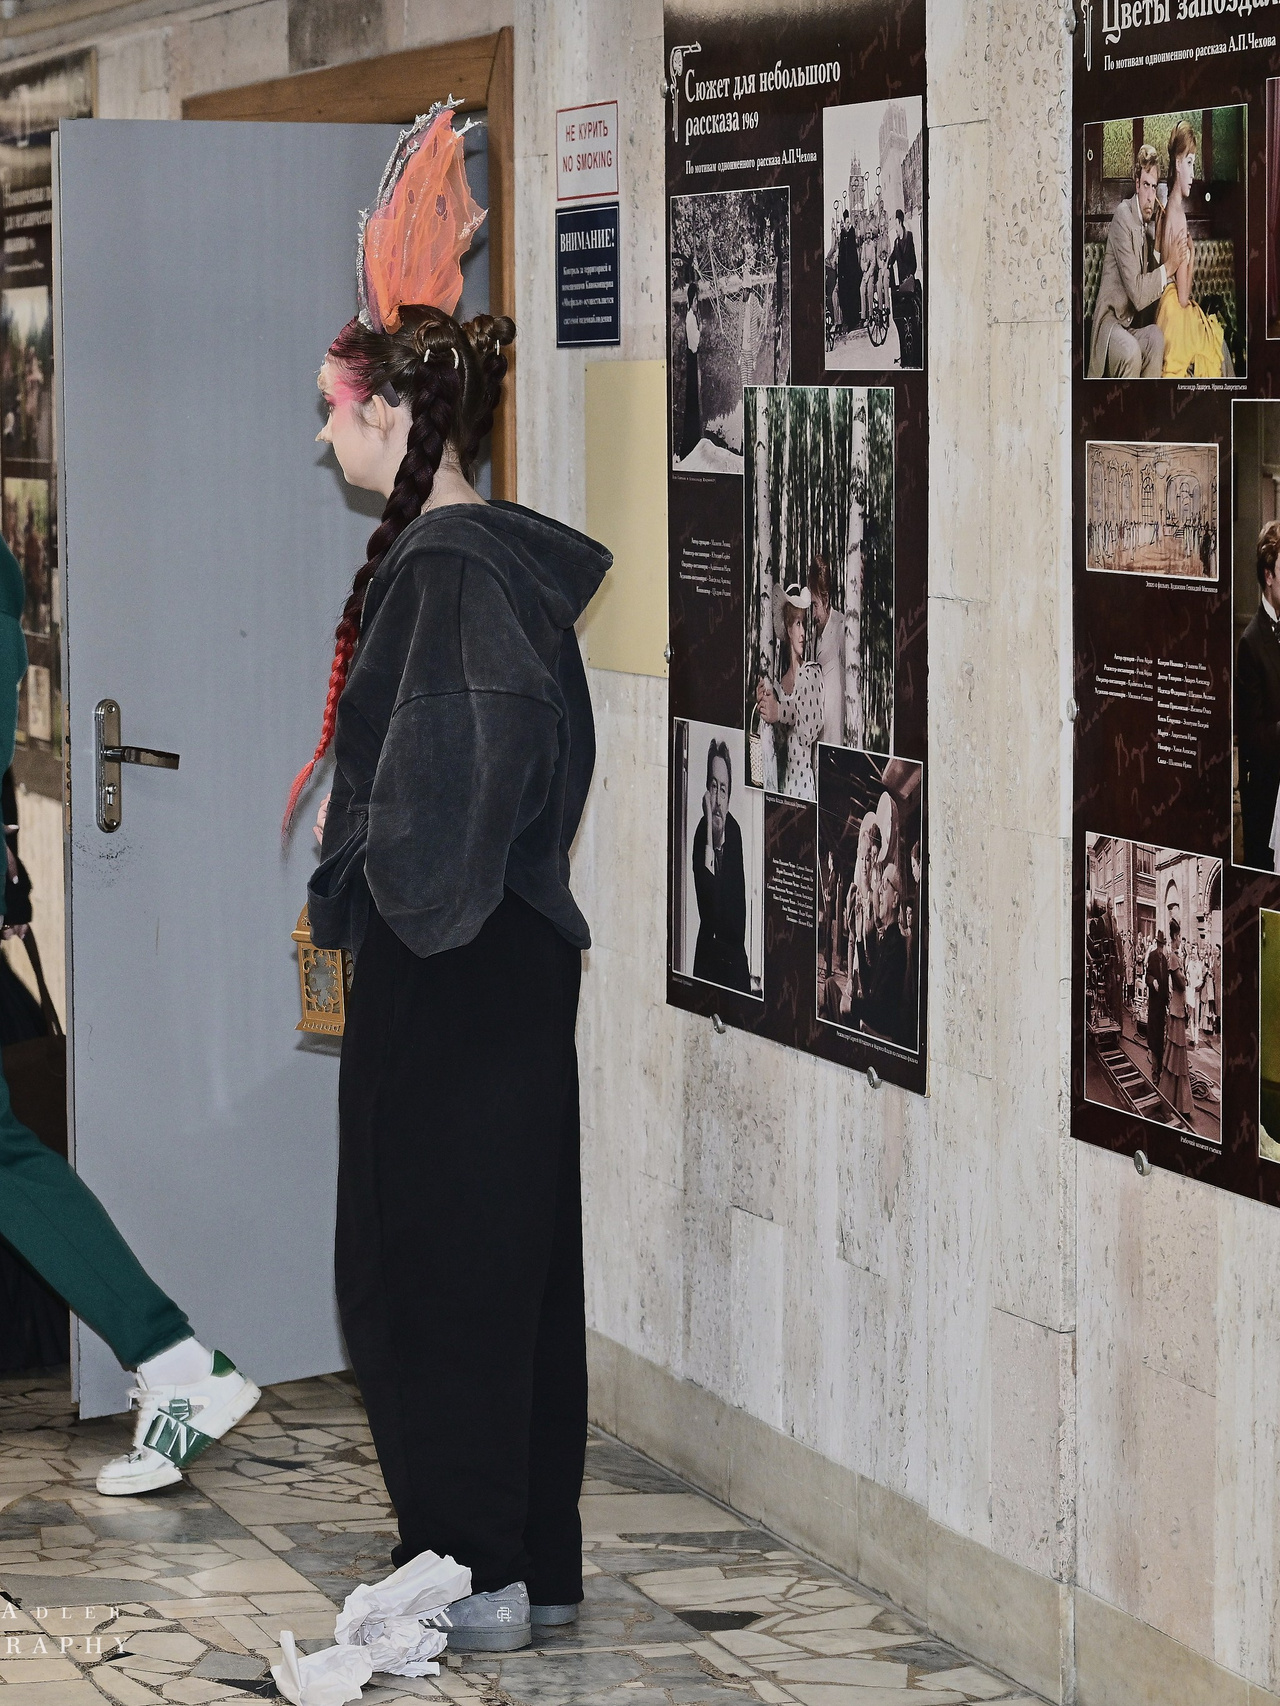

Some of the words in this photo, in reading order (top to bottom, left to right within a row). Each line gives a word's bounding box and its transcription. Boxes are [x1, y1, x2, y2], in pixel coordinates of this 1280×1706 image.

[1102, 0, 1171, 45] Цветы
[1104, 55, 1115, 71] По
[1116, 56, 1144, 69] мотивам
[1145, 48, 1194, 66] одноименного
[1195, 42, 1227, 61] рассказа
[1228, 32, 1277, 53] А.П.Чехова
[684, 69, 730, 103] Сюжет
[732, 74, 756, 101] для
[759, 59, 841, 93] небольшого
[565, 125, 576, 142] НЕ
[579, 120, 609, 141] КУРИТЬ
[685, 111, 740, 146] рассказа
[741, 111, 759, 130] 1969
[562, 155, 574, 172] NO
[576, 149, 613, 171] SMOKING
[560, 228, 615, 252] ВНИМАНИЕ!
